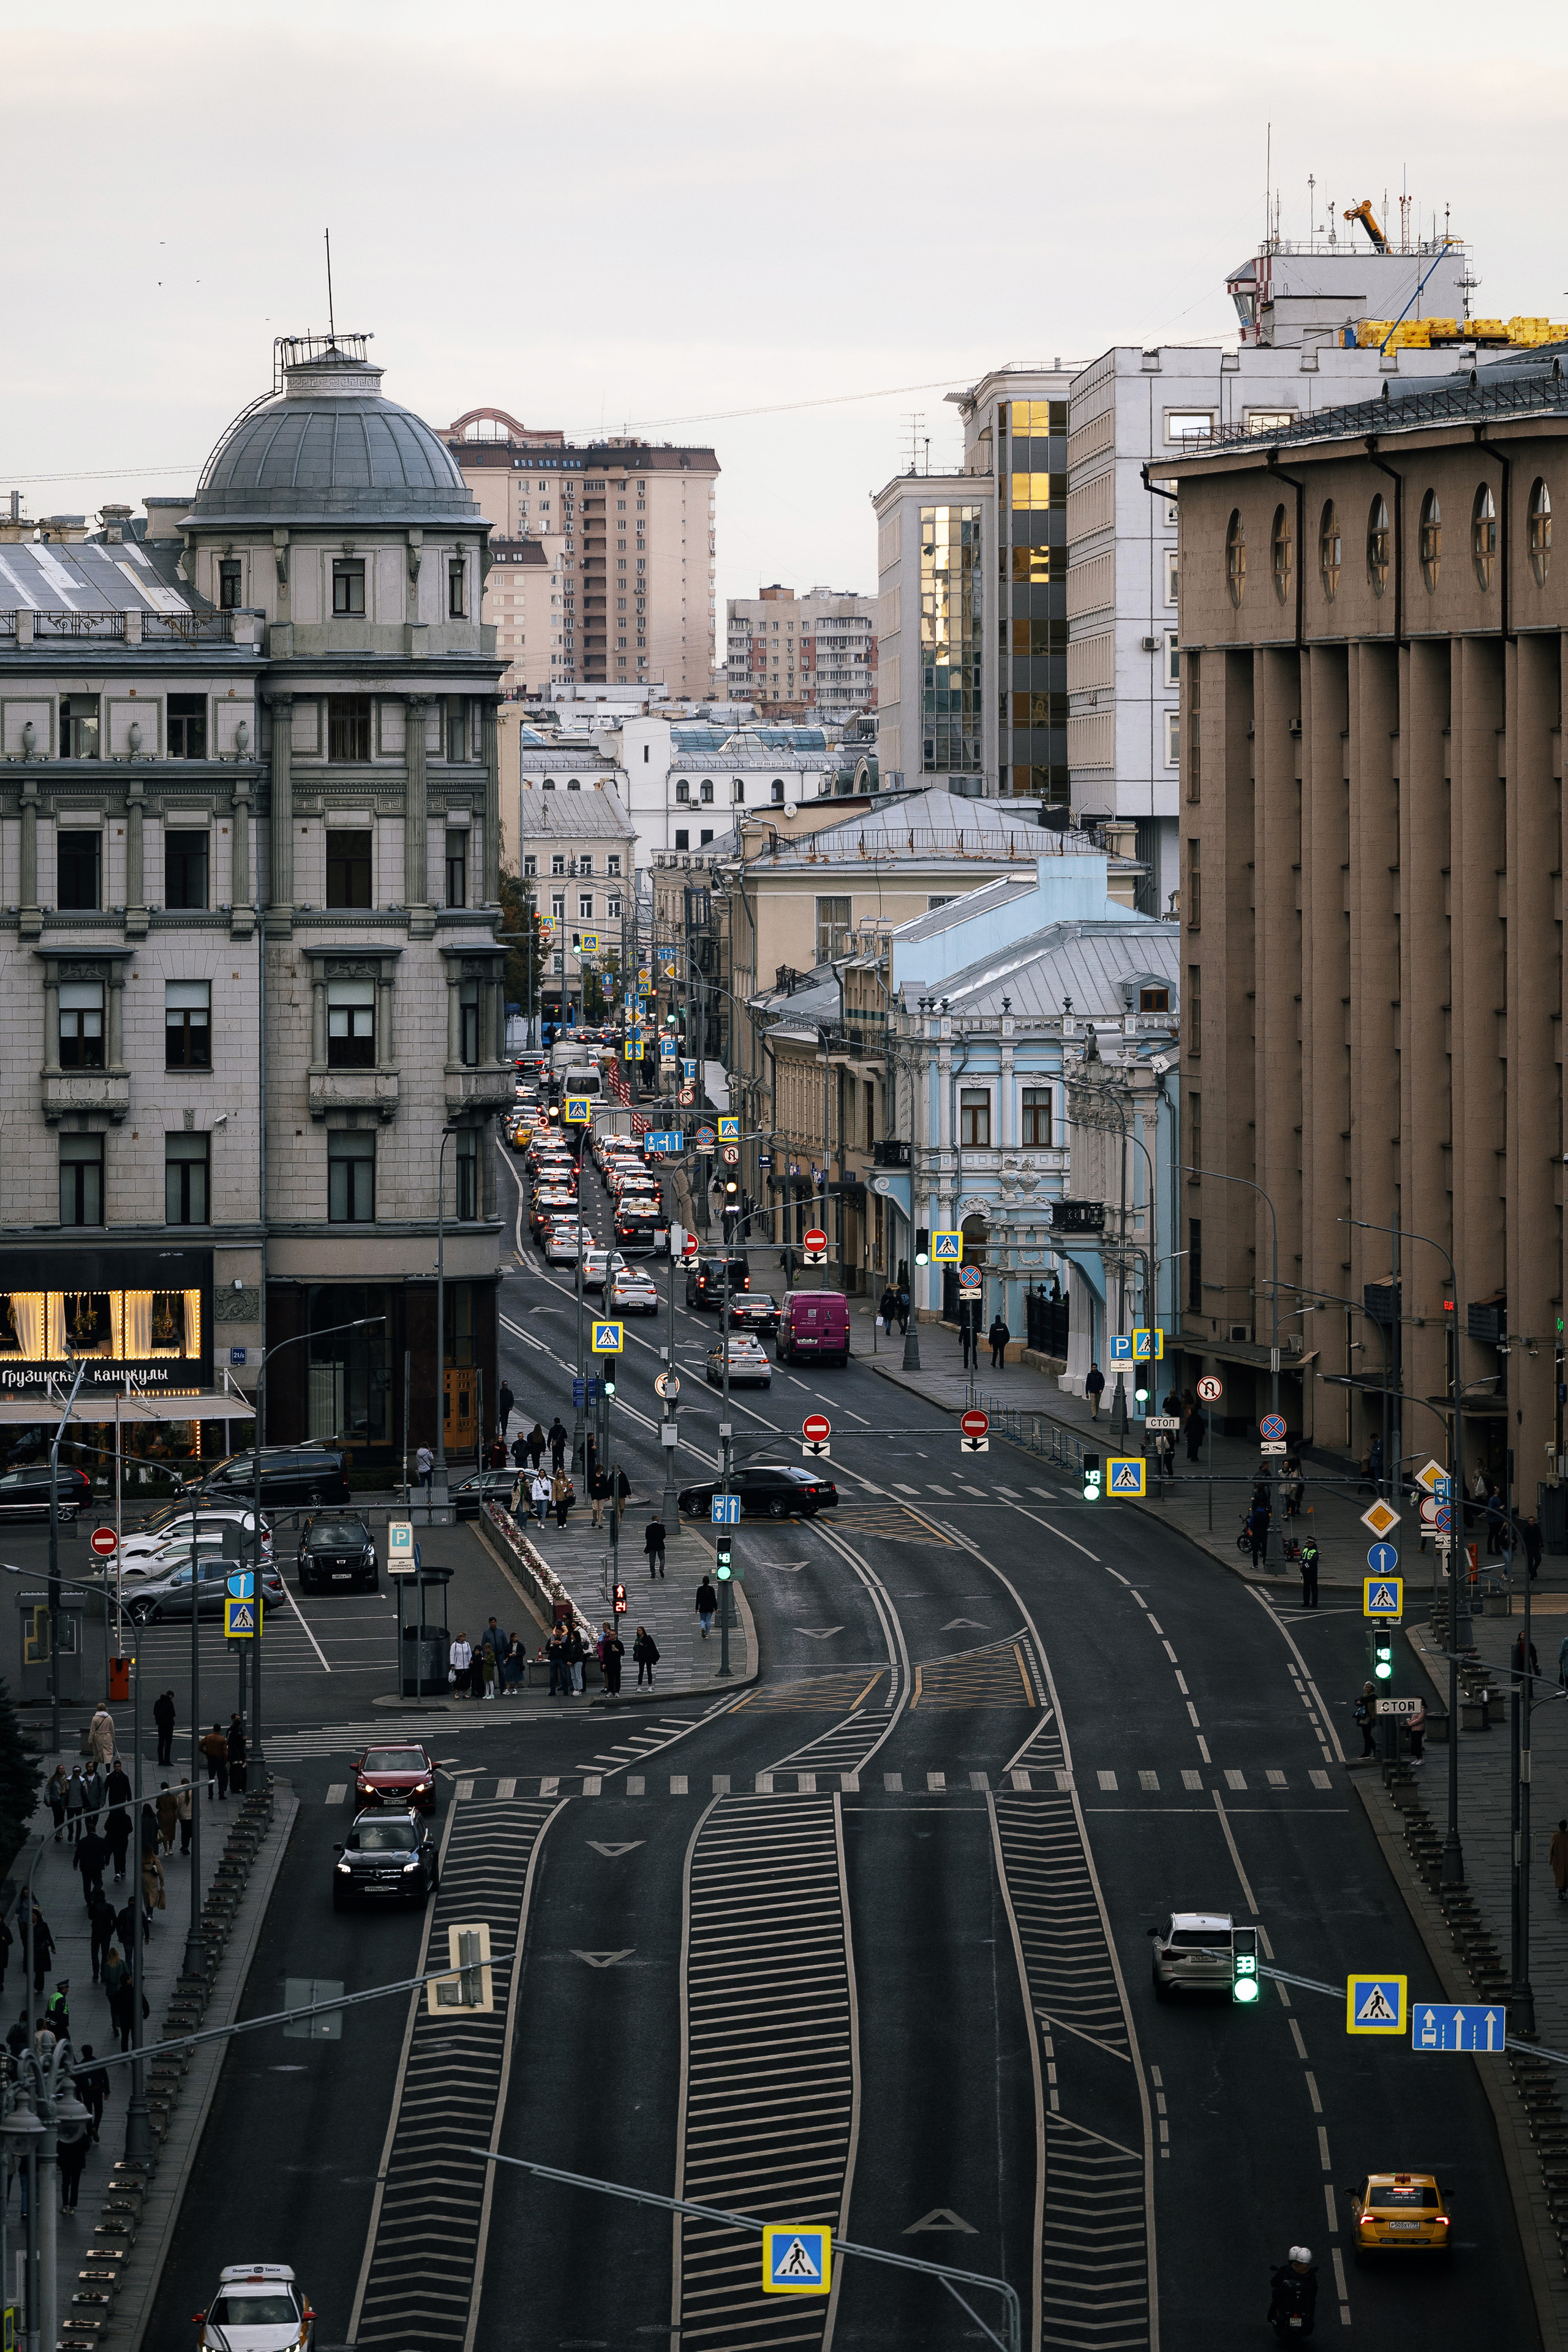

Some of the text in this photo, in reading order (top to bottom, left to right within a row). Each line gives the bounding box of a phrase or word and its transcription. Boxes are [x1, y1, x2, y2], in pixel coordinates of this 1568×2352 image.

[665, 1042, 674, 1054] P
[1116, 1338, 1129, 1356] P
[94, 1369, 168, 1385] каникулы
[1085, 1470, 1100, 1484] 49
[396, 1531, 407, 1544] P
[718, 1553, 730, 1563] 48
[616, 1602, 626, 1611] 24
[1382, 1702, 1415, 1711] СТОП
[1237, 1956, 1255, 1973] 33
